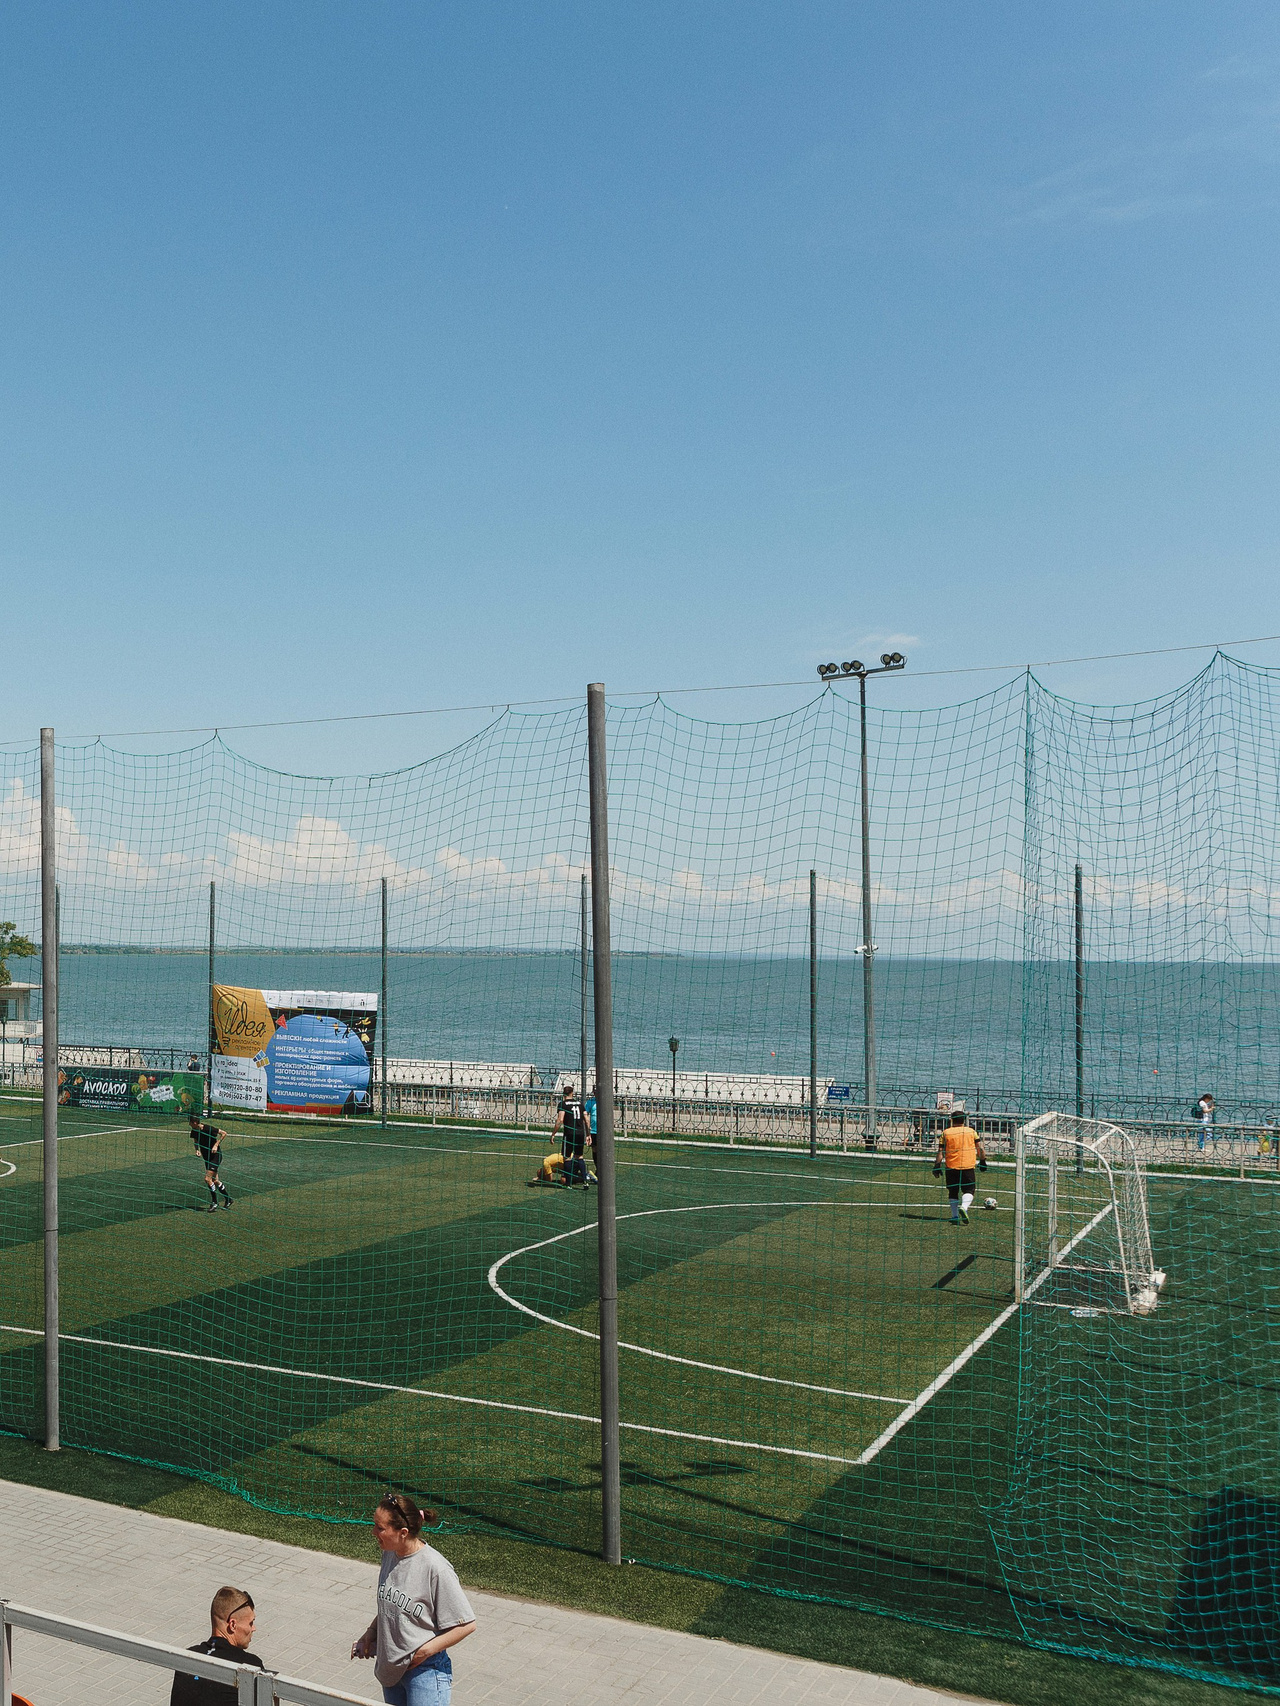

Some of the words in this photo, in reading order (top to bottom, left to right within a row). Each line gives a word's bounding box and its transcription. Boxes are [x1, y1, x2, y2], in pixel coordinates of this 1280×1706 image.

[83, 1080, 127, 1095] AVOCADO
[274, 1089, 307, 1098] РЕКЛАМНАЯ
[571, 1105, 581, 1120] 11
